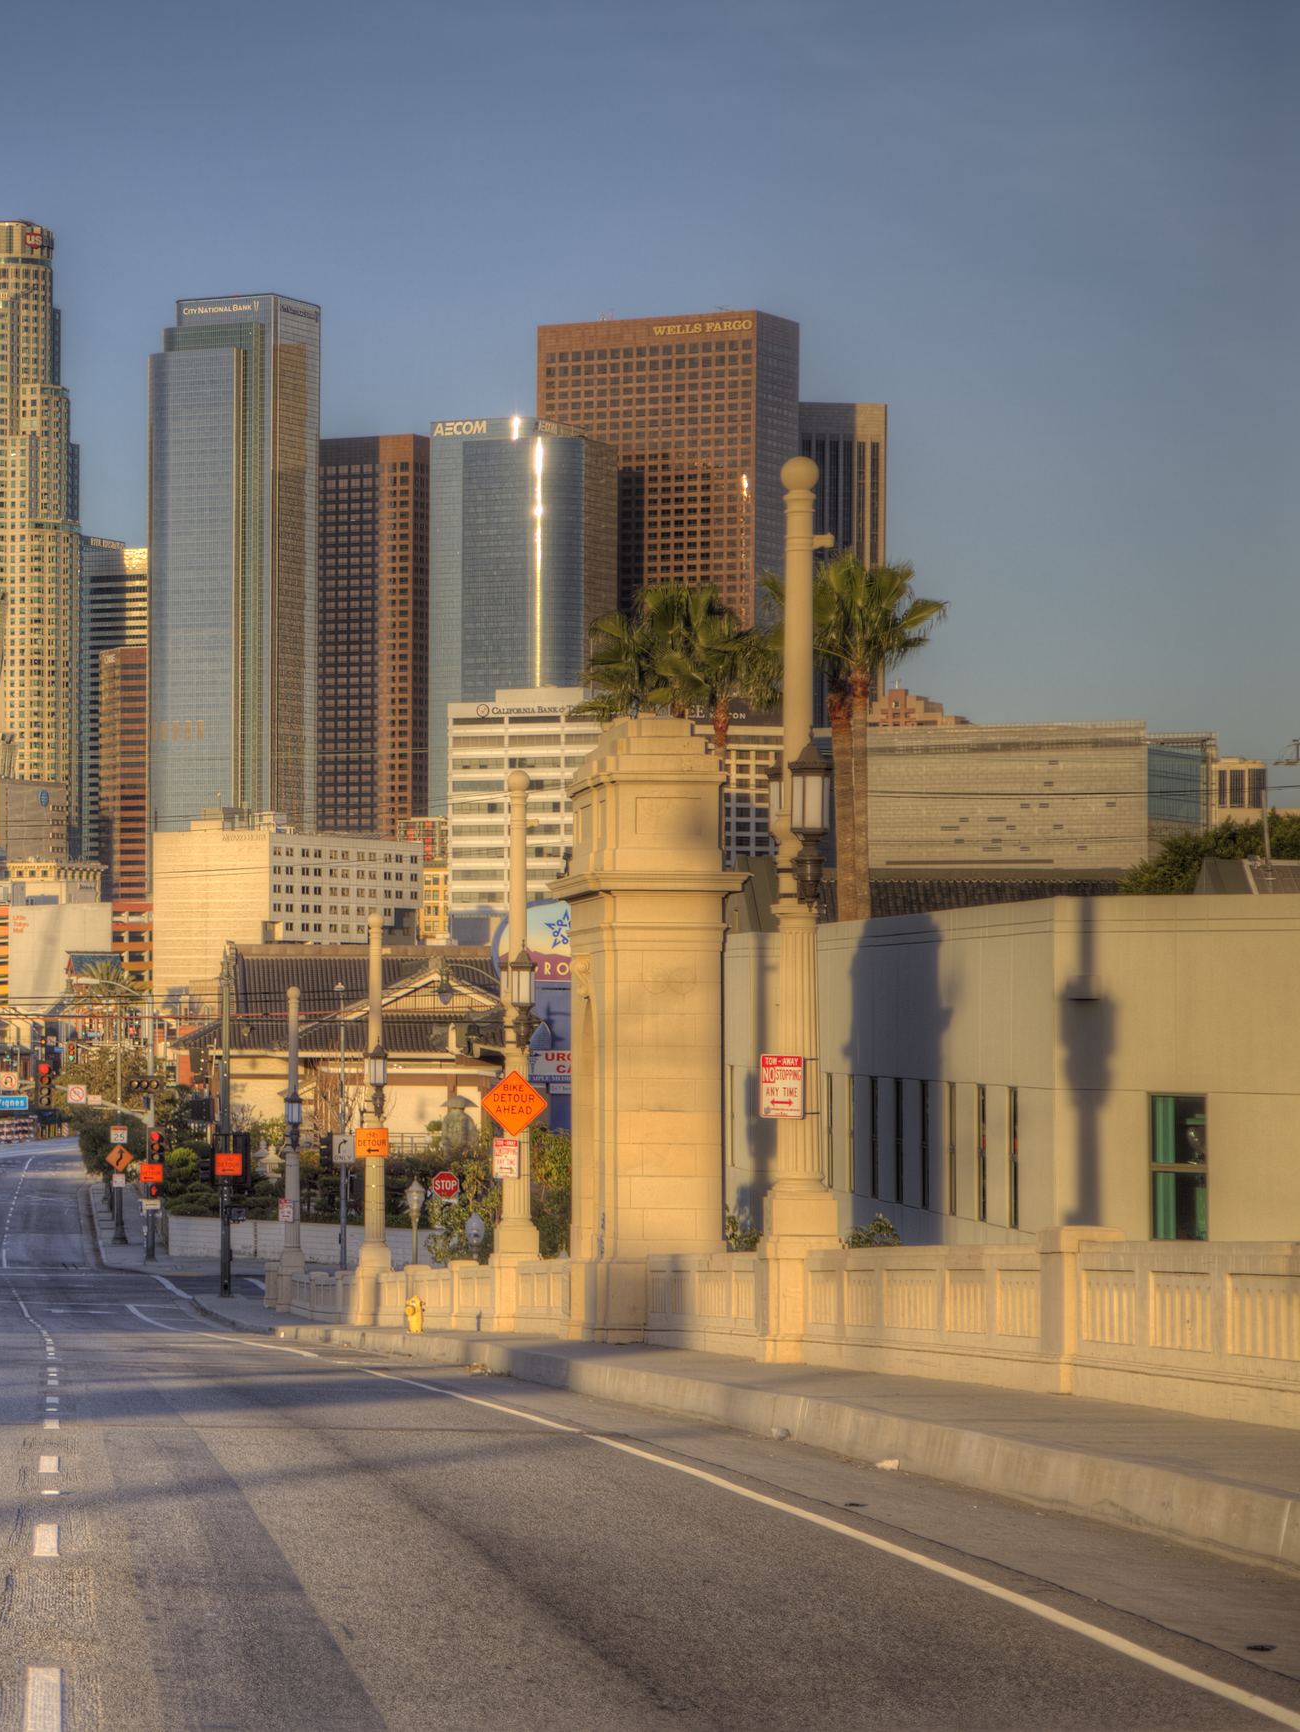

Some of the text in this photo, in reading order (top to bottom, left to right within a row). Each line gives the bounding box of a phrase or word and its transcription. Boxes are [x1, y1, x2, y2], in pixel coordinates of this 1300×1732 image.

[198, 306, 233, 314] NATIONAL
[233, 304, 253, 312] BANK
[653, 319, 753, 336] WELLS FARGO
[433, 420, 487, 436] AECOM
[492, 706, 535, 715] CALIFORNIA
[763, 1067, 802, 1081] NO STOPPING
[503, 1084, 524, 1092] BIKE
[766, 1087, 798, 1097] ANY TIME
[493, 1093, 535, 1103] DETOUR
[496, 1105, 533, 1115] AHEAD
[434, 1180, 457, 1191] STOP
